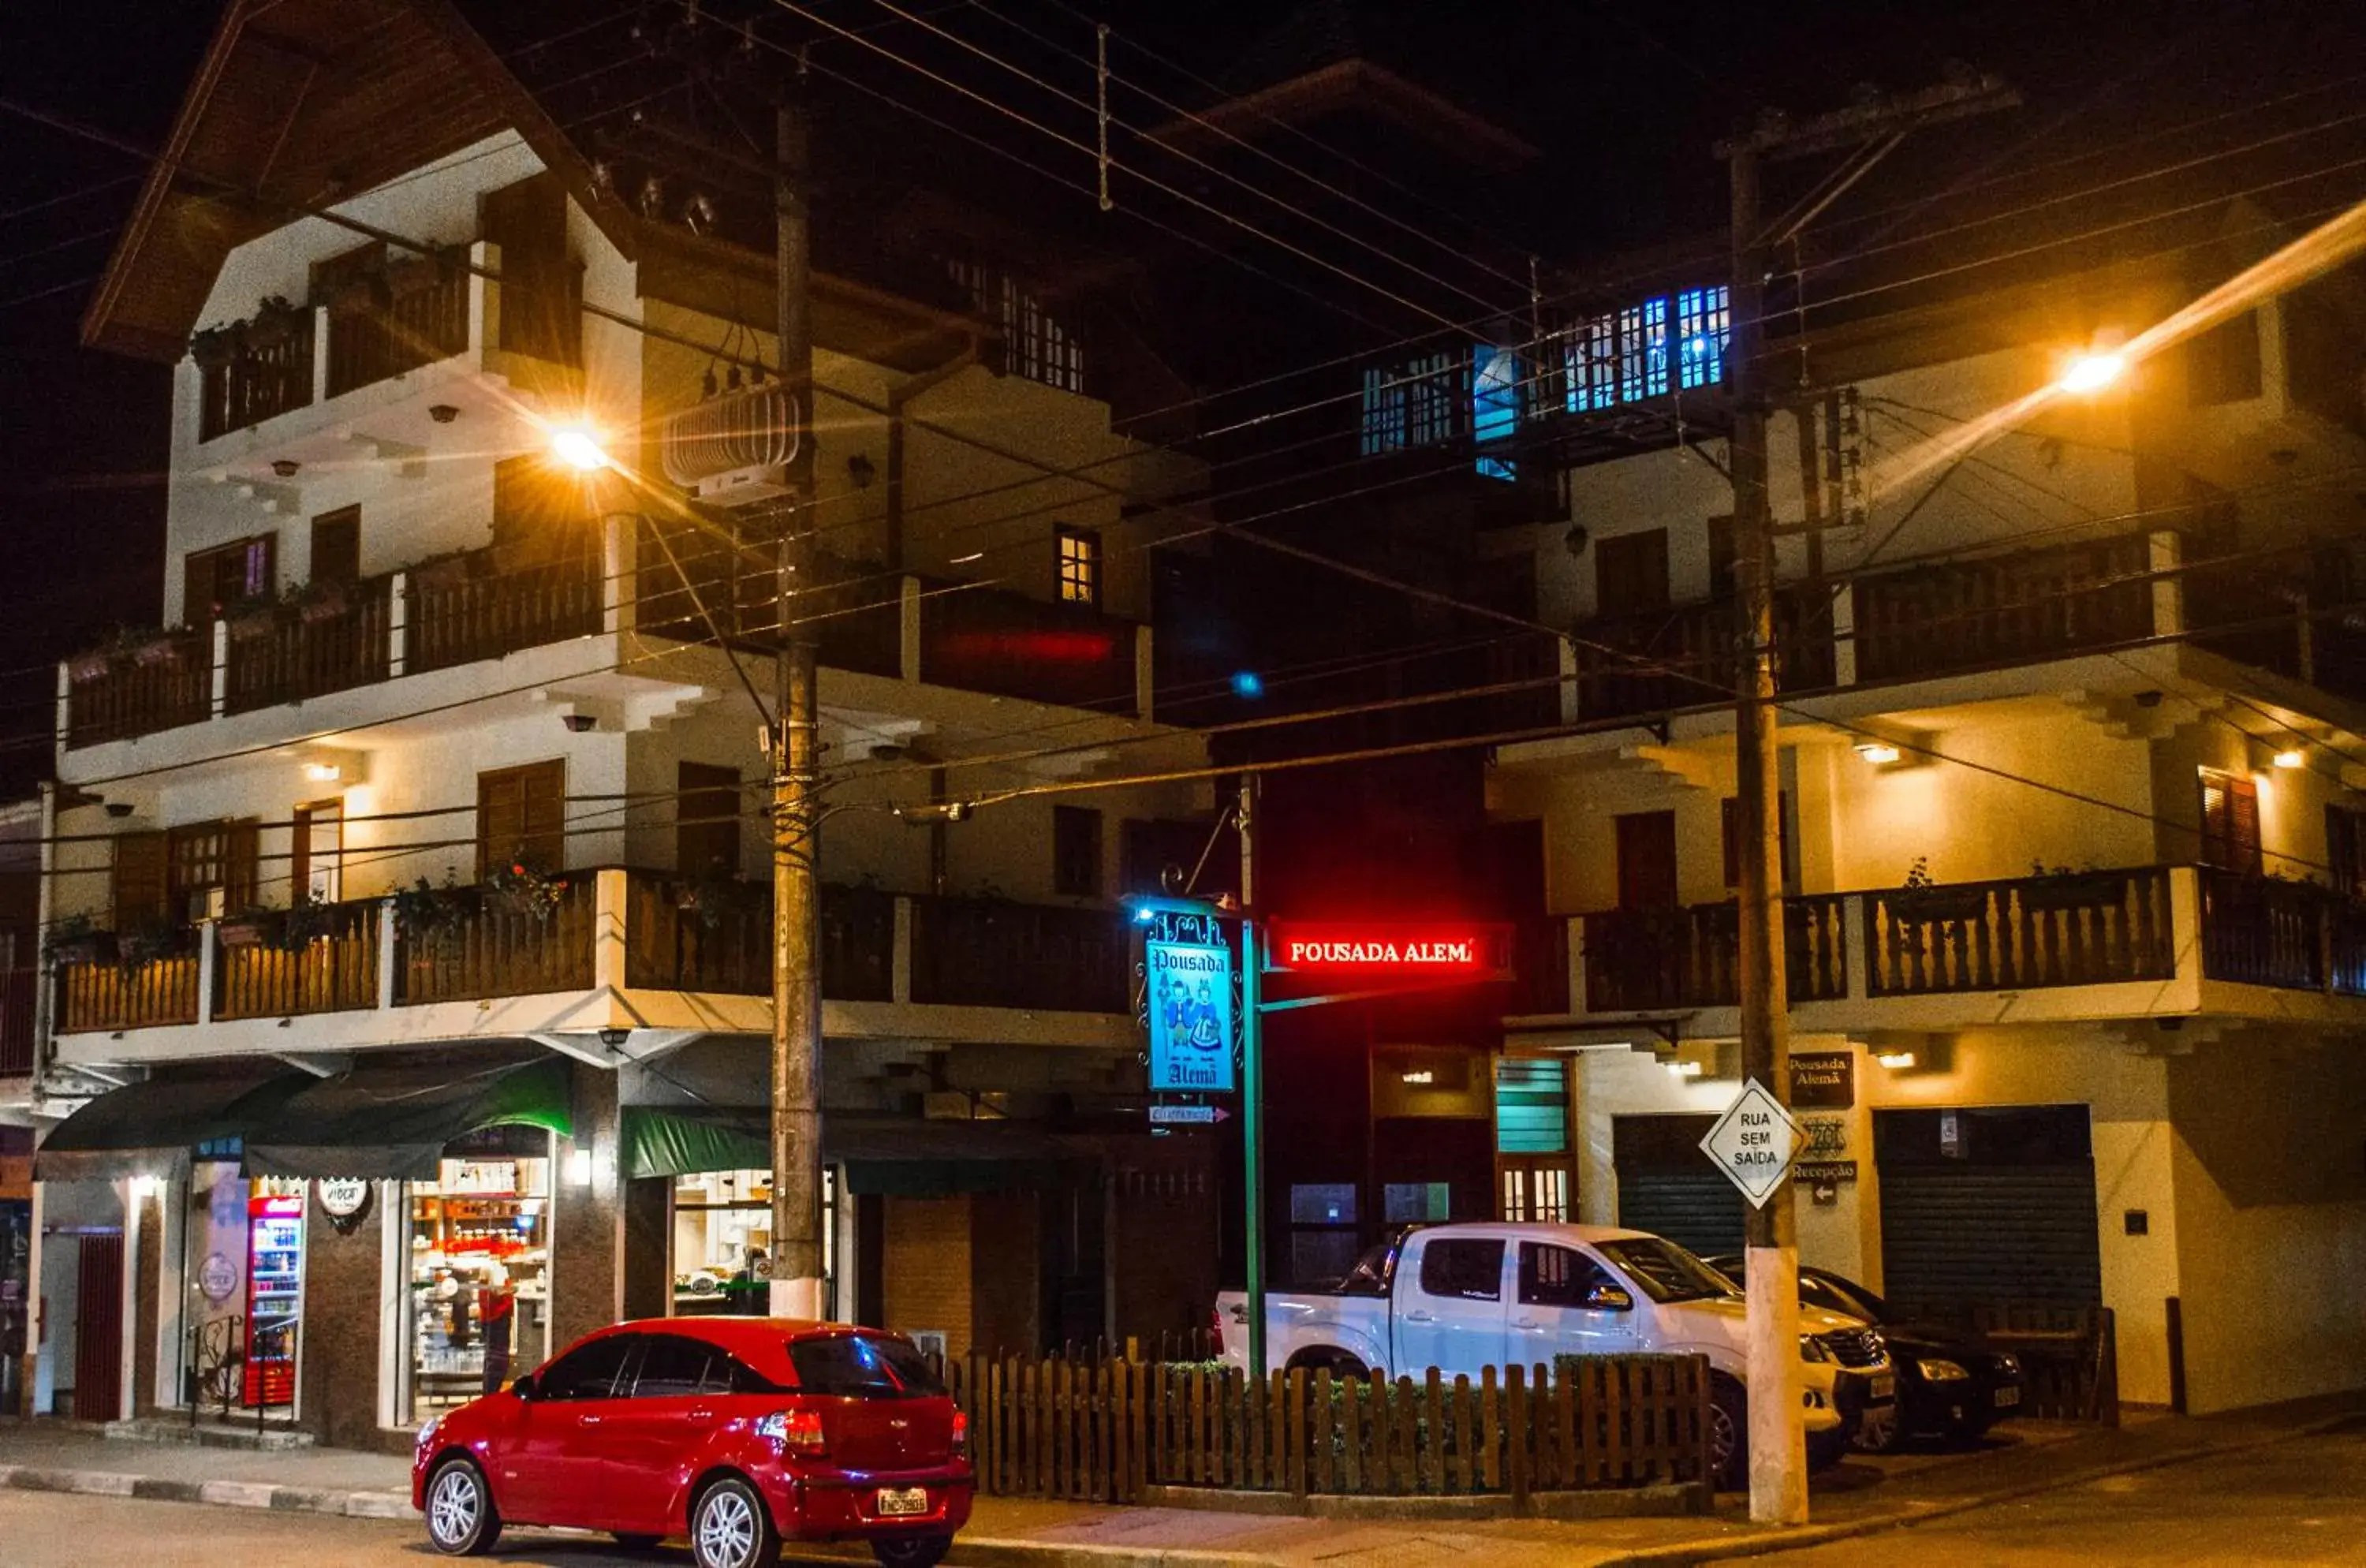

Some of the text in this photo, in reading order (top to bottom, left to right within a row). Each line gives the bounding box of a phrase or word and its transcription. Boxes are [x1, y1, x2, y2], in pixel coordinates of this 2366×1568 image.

[1291, 943, 1400, 962] POUSADA
[1154, 949, 1225, 973] Pousada
[1789, 1058, 1846, 1070] Pousada
[1169, 1063, 1217, 1085] Alemã
[1797, 1071, 1841, 1085] Alemã
[1741, 1112, 1771, 1126] RUA
[1741, 1131, 1771, 1146] SEM
[1734, 1147, 1777, 1165] SAÍDA
